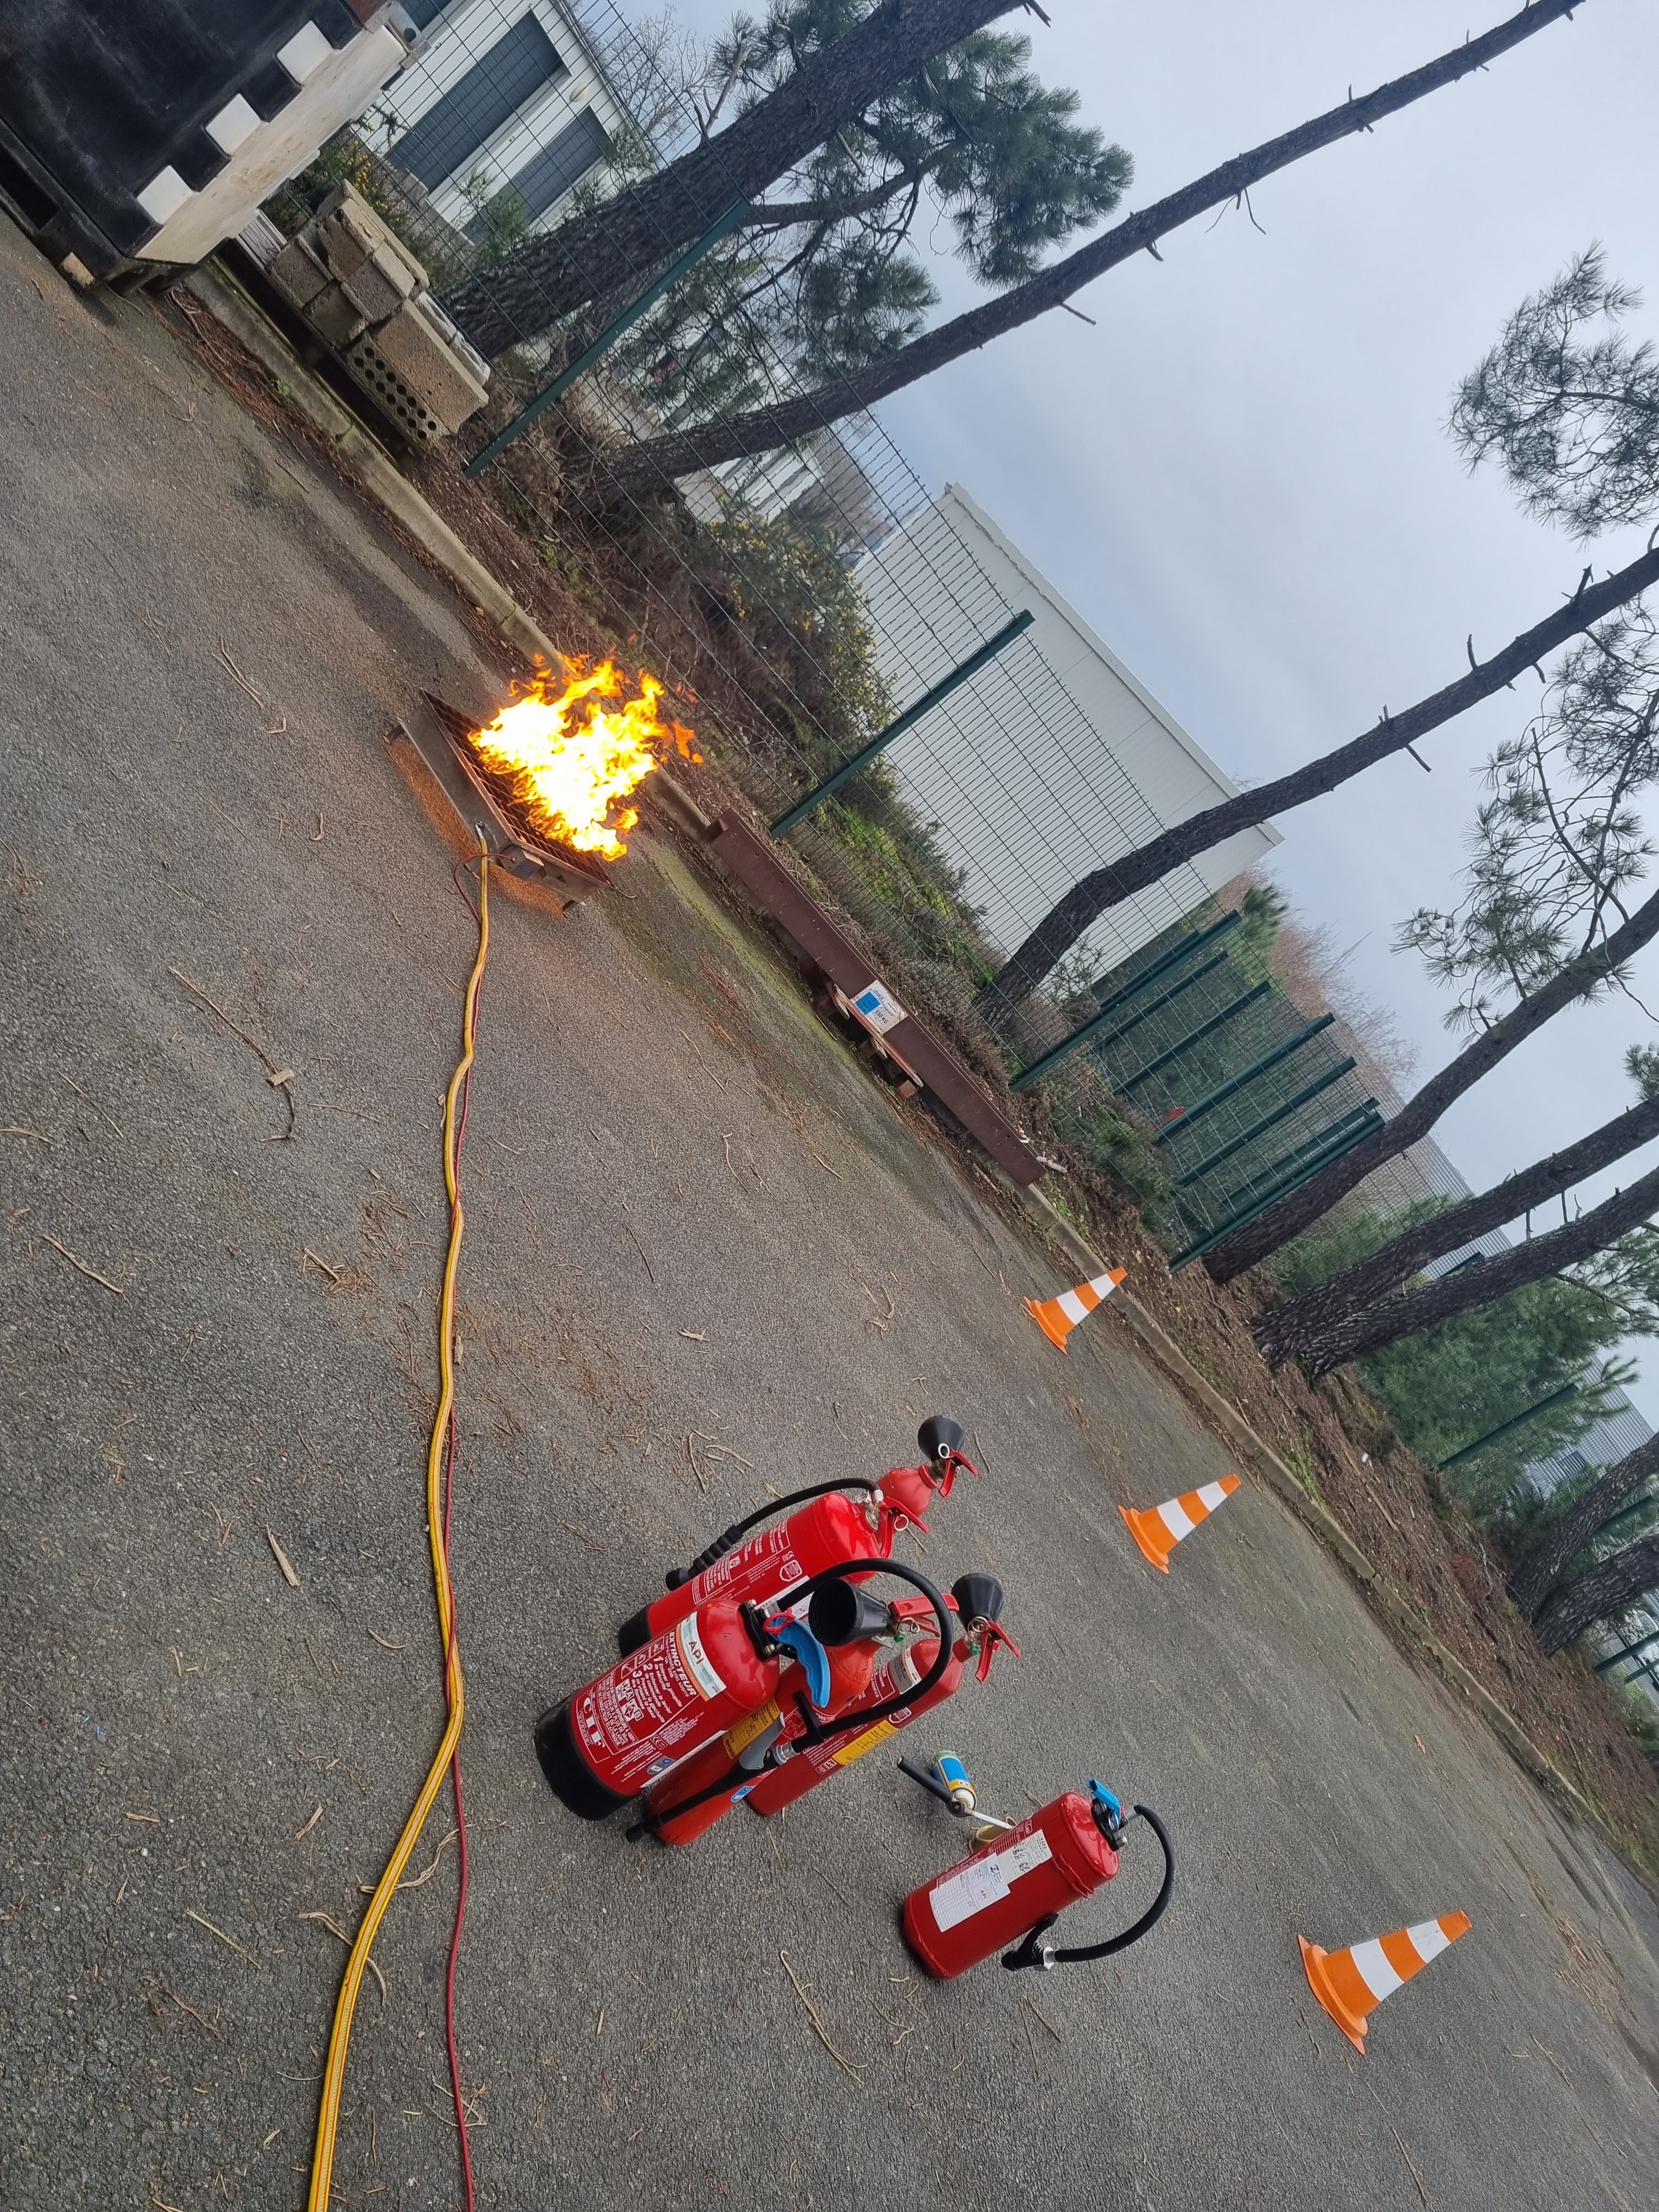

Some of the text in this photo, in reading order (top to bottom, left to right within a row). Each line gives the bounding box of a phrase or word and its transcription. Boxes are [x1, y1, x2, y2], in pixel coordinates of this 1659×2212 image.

[874, 1009, 883, 1018] 550
[669, 1632, 696, 1695] EXTINCTEUR
[689, 1641, 704, 1664] API
[642, 1663, 653, 1671] 2
[648, 1672, 661, 1695] Enfoncer
[661, 1700, 672, 1714] levier
[646, 1679, 662, 1707] commande
[656, 1670, 667, 1691] sécurité
[658, 1662, 668, 1682] Enlever
[667, 1687, 682, 1707] goupille
[678, 1681, 689, 1697] ADDITIF
[870, 1681, 879, 1698] GOUPILLE
[597, 1696, 609, 1723] CONDUCTEUR
[610, 1693, 619, 1709] TENSION
[615, 1707, 628, 1730] INFÉRIEURE
[633, 1688, 646, 1710] flammes
[637, 1685, 647, 1701] visant
[646, 1706, 656, 1719] base
[639, 1677, 650, 1697] Presser
[648, 1702, 665, 1723] gachette
[583, 1697, 605, 1748] CIF
[603, 1700, 612, 1719] CONTACT
[614, 1730, 627, 1745] LANCE
